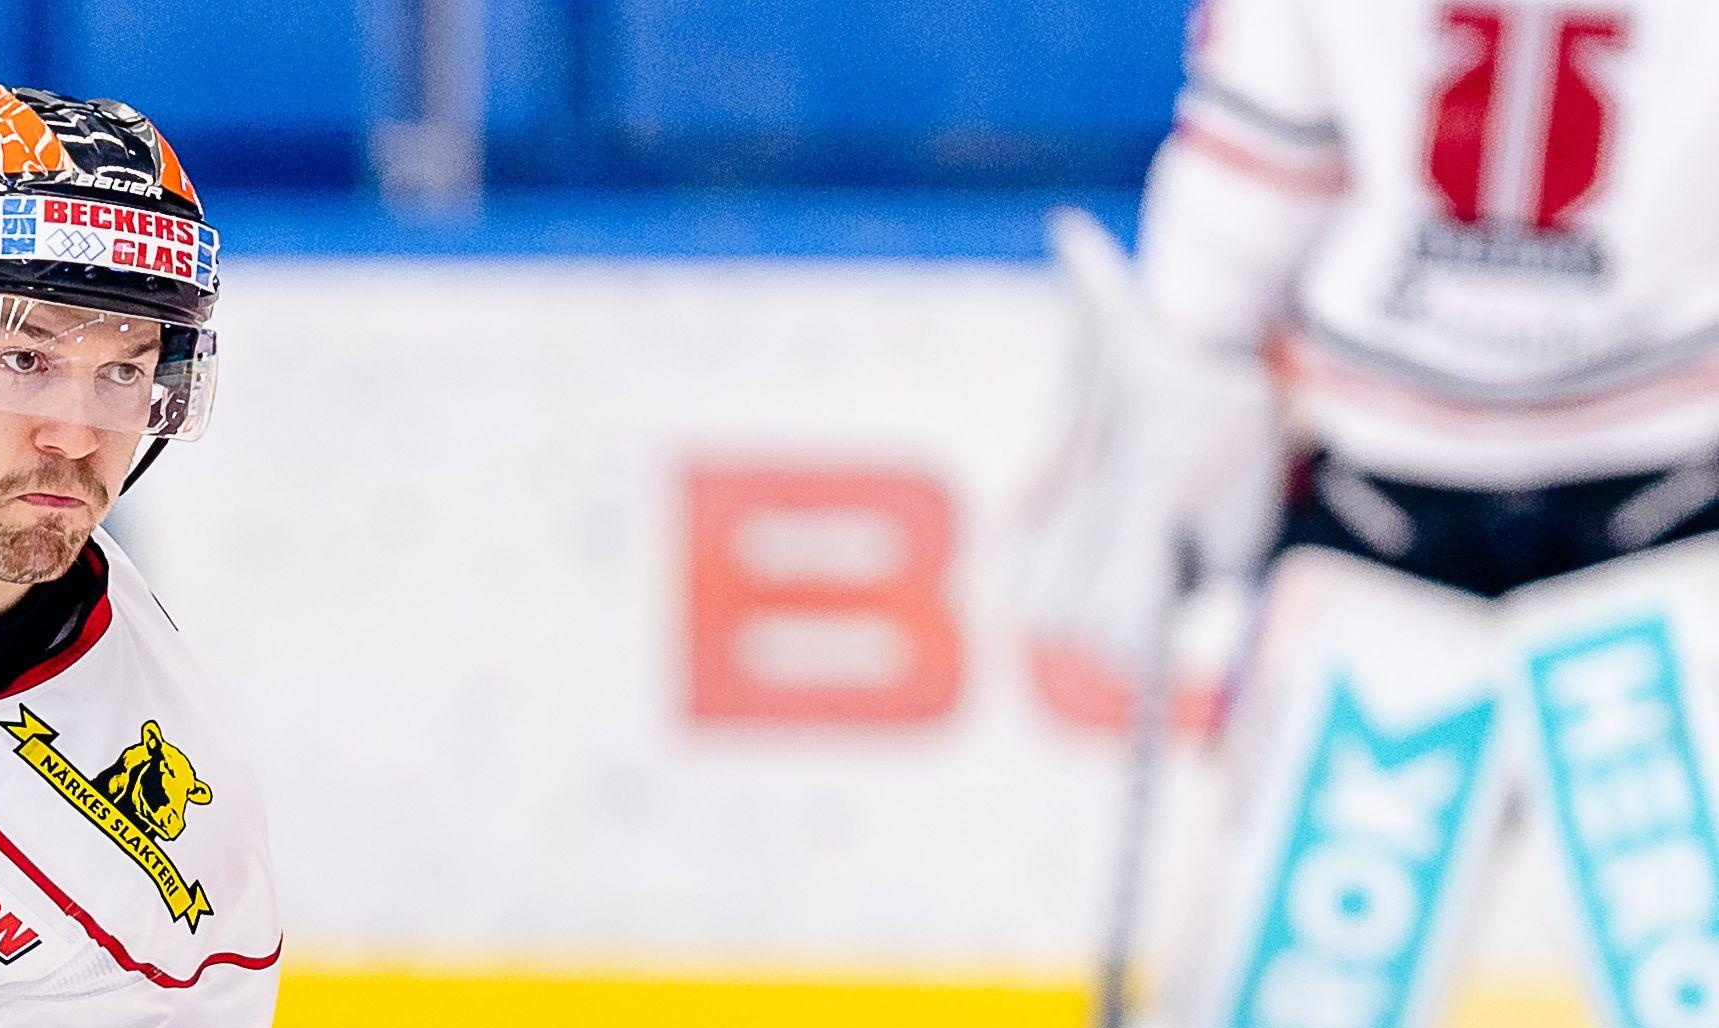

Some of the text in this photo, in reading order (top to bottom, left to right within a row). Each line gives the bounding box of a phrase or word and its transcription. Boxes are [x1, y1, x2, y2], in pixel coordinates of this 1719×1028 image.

[43, 198, 194, 246] BECKERS
[111, 238, 192, 279] GLAS
[38, 753, 182, 898] NÄRKES SLAKTERI
